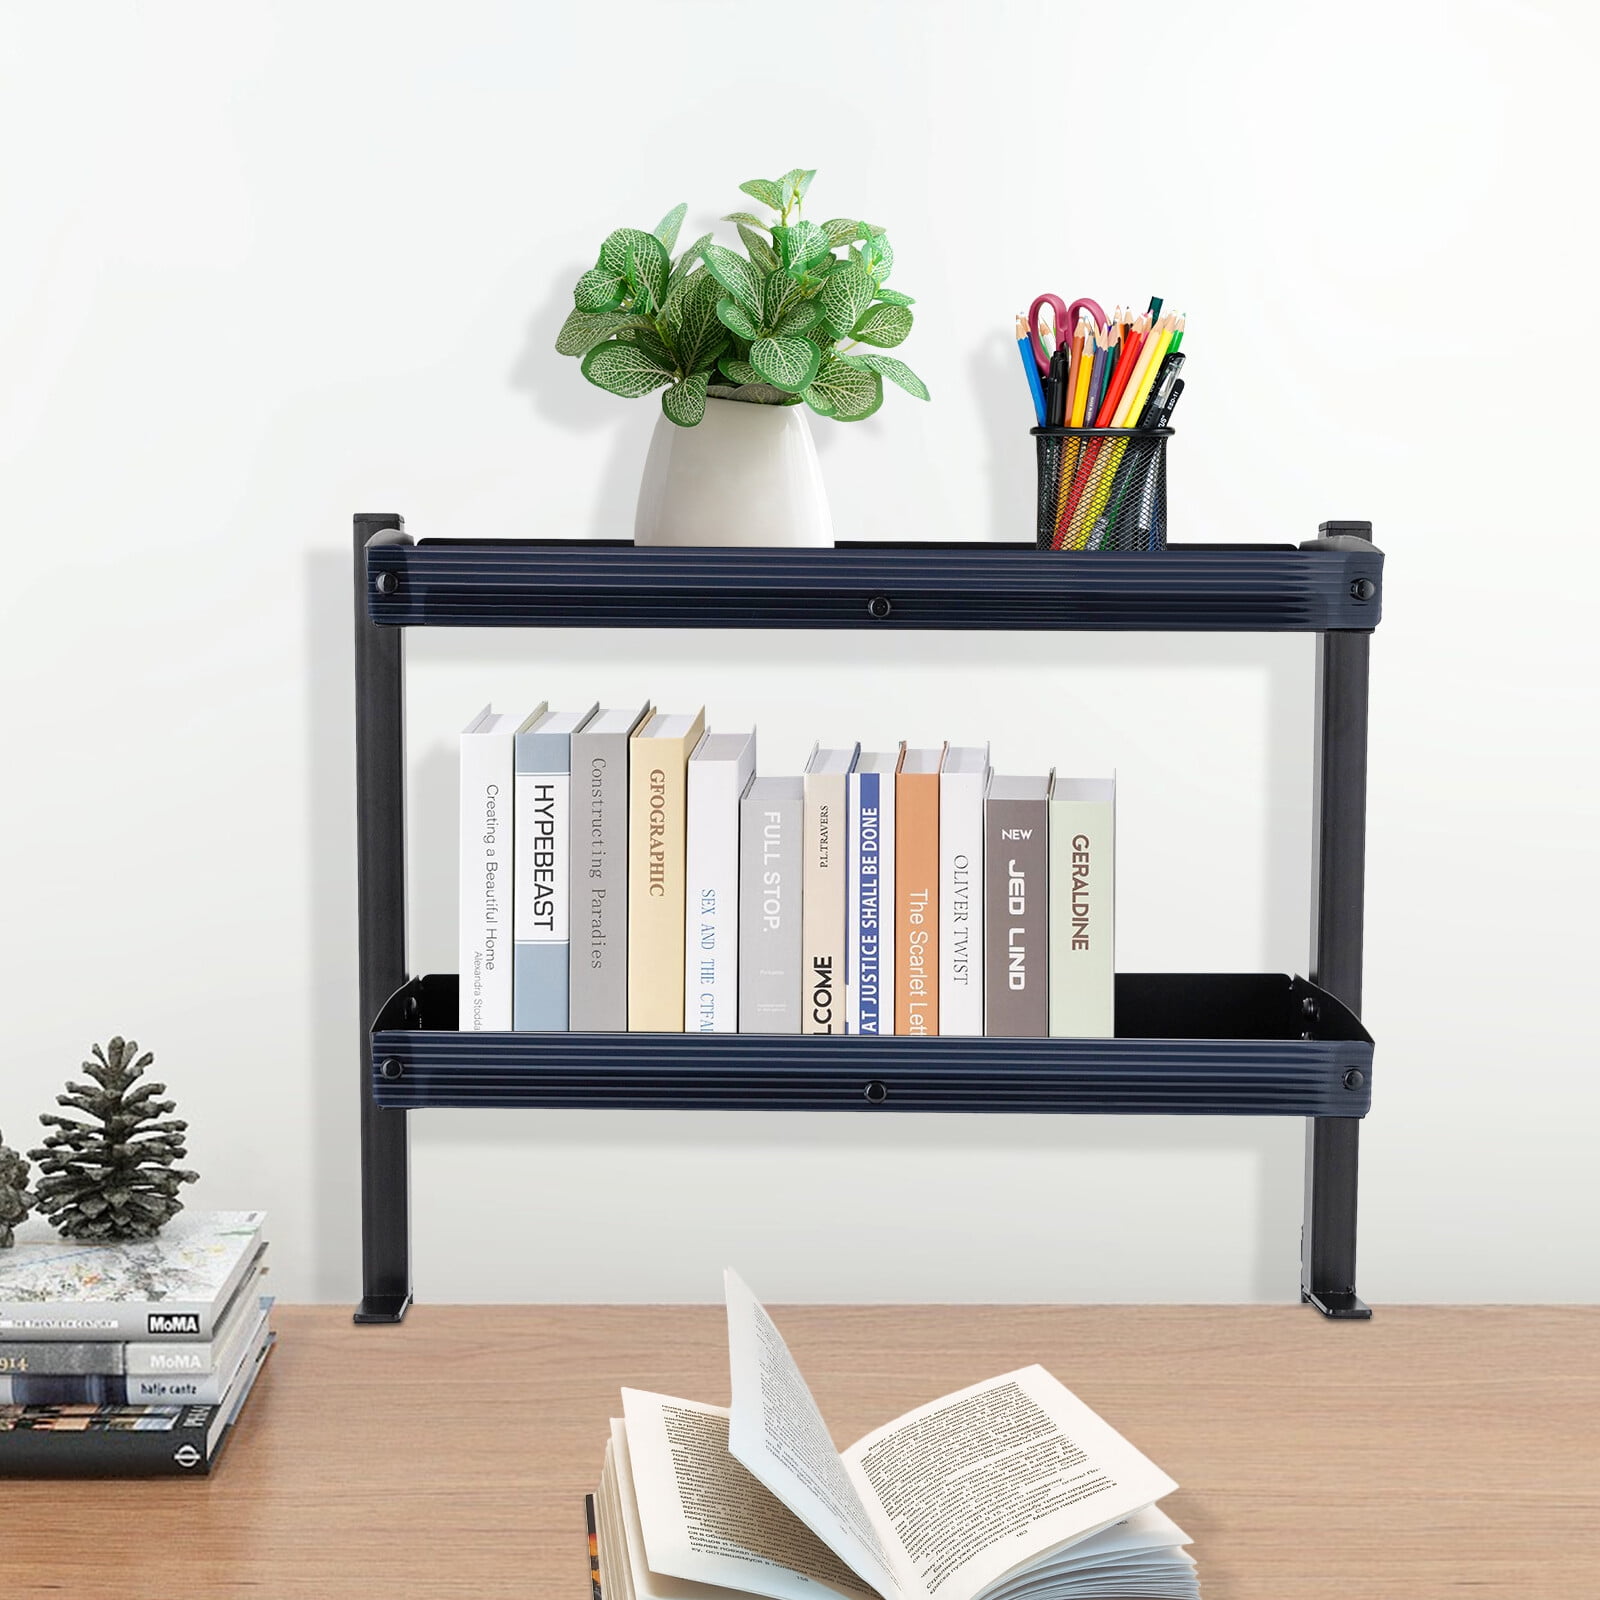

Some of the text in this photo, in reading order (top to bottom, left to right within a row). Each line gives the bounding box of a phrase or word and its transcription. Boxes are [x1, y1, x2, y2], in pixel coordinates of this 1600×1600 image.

[534, 784, 554, 931] HYPEBEAST
[589, 758, 607, 969] Constructing Paradies
[1002, 828, 1032, 840] NEW
[483, 784, 499, 971] Creating a Beautiful Home
[701, 889, 716, 915] SEX
[762, 811, 780, 932] FULL STOP.
[1072, 834, 1089, 951] GERALDINE
[700, 924, 715, 950] AND
[862, 808, 878, 1033] AT JUSTICE SHALL BE DONE
[909, 888, 928, 925] The
[954, 854, 968, 986] OLIVER TWIST
[1008, 859, 1026, 990] JED LIND
[473, 951, 483, 997] Alexandra
[700, 959, 714, 985] THE
[909, 930, 928, 996] Scarlet
[150, 1316, 198, 1332] MoMA
[150, 1355, 201, 1368] MoMA
